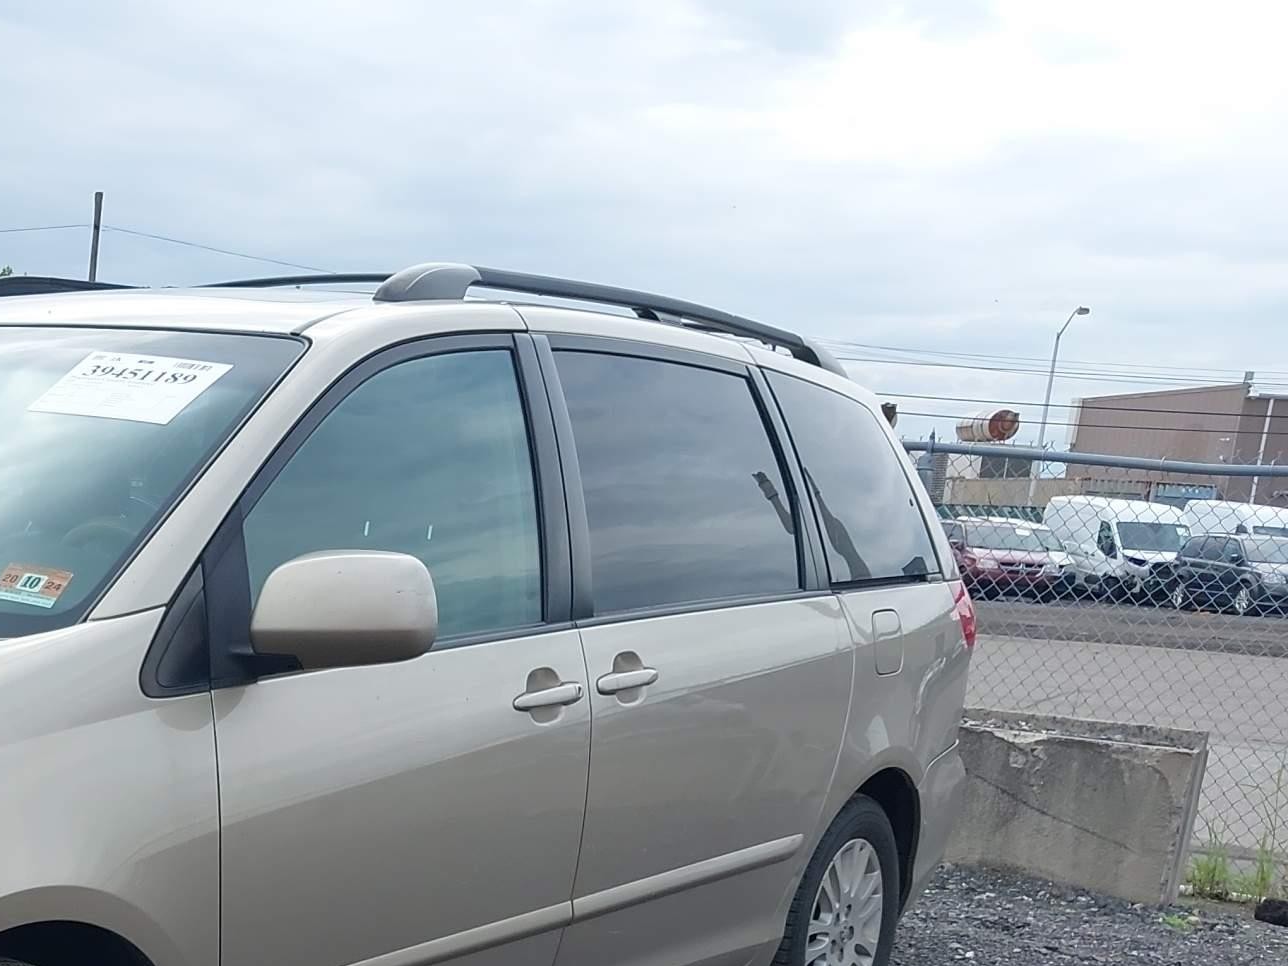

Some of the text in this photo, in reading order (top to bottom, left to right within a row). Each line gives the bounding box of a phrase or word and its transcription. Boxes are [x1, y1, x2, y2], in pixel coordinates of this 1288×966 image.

[82, 365, 198, 385] 39451189
[2, 573, 62, 591] 20 10 24
